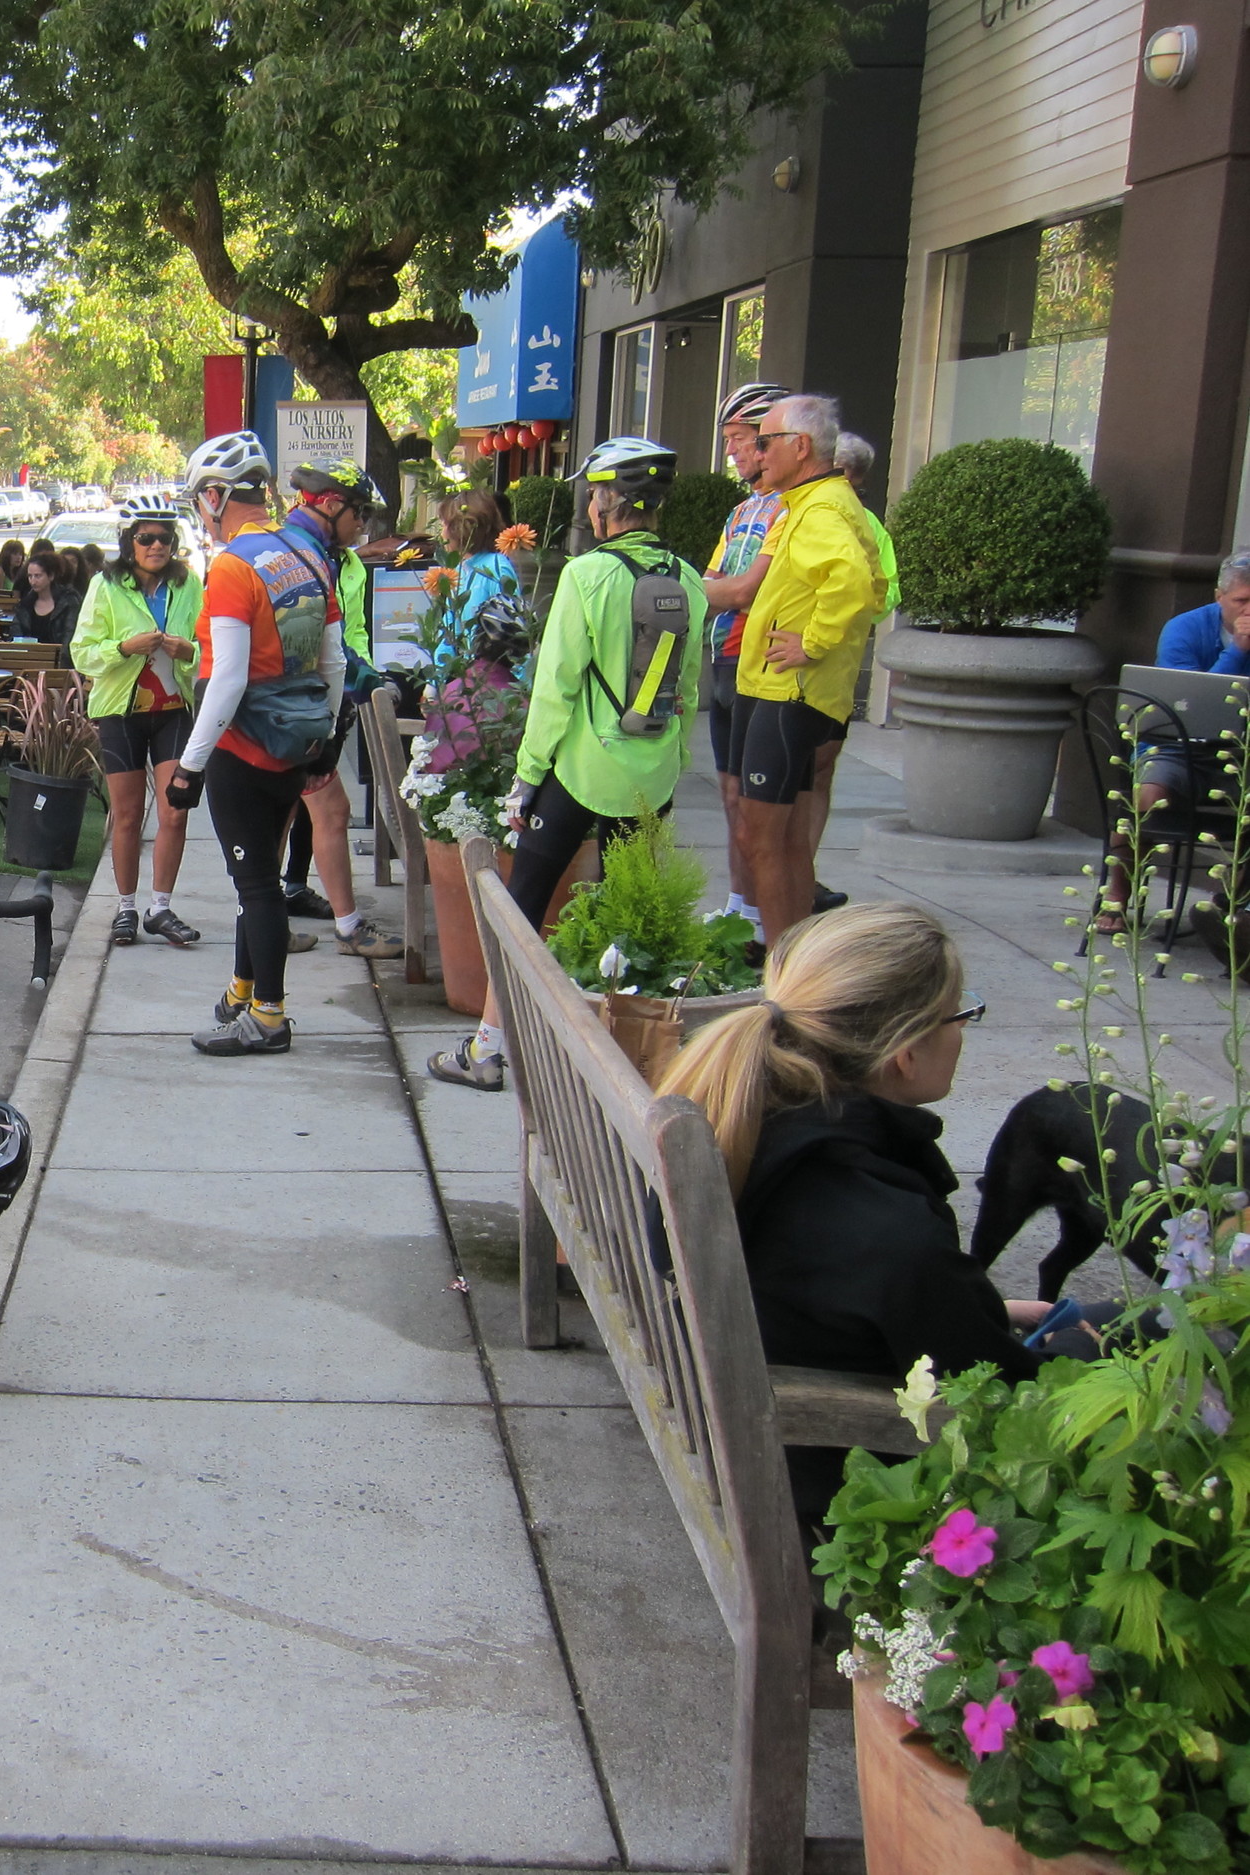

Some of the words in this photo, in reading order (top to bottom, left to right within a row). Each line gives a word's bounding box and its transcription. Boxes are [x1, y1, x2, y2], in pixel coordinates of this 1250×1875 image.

[288, 410, 308, 426] LOS
[312, 410, 345, 426] ALTOS
[302, 425, 355, 440] NURSERY
[287, 441, 299, 450] 245
[301, 441, 339, 450] Hawthorne
[340, 441, 354, 450] Ave
